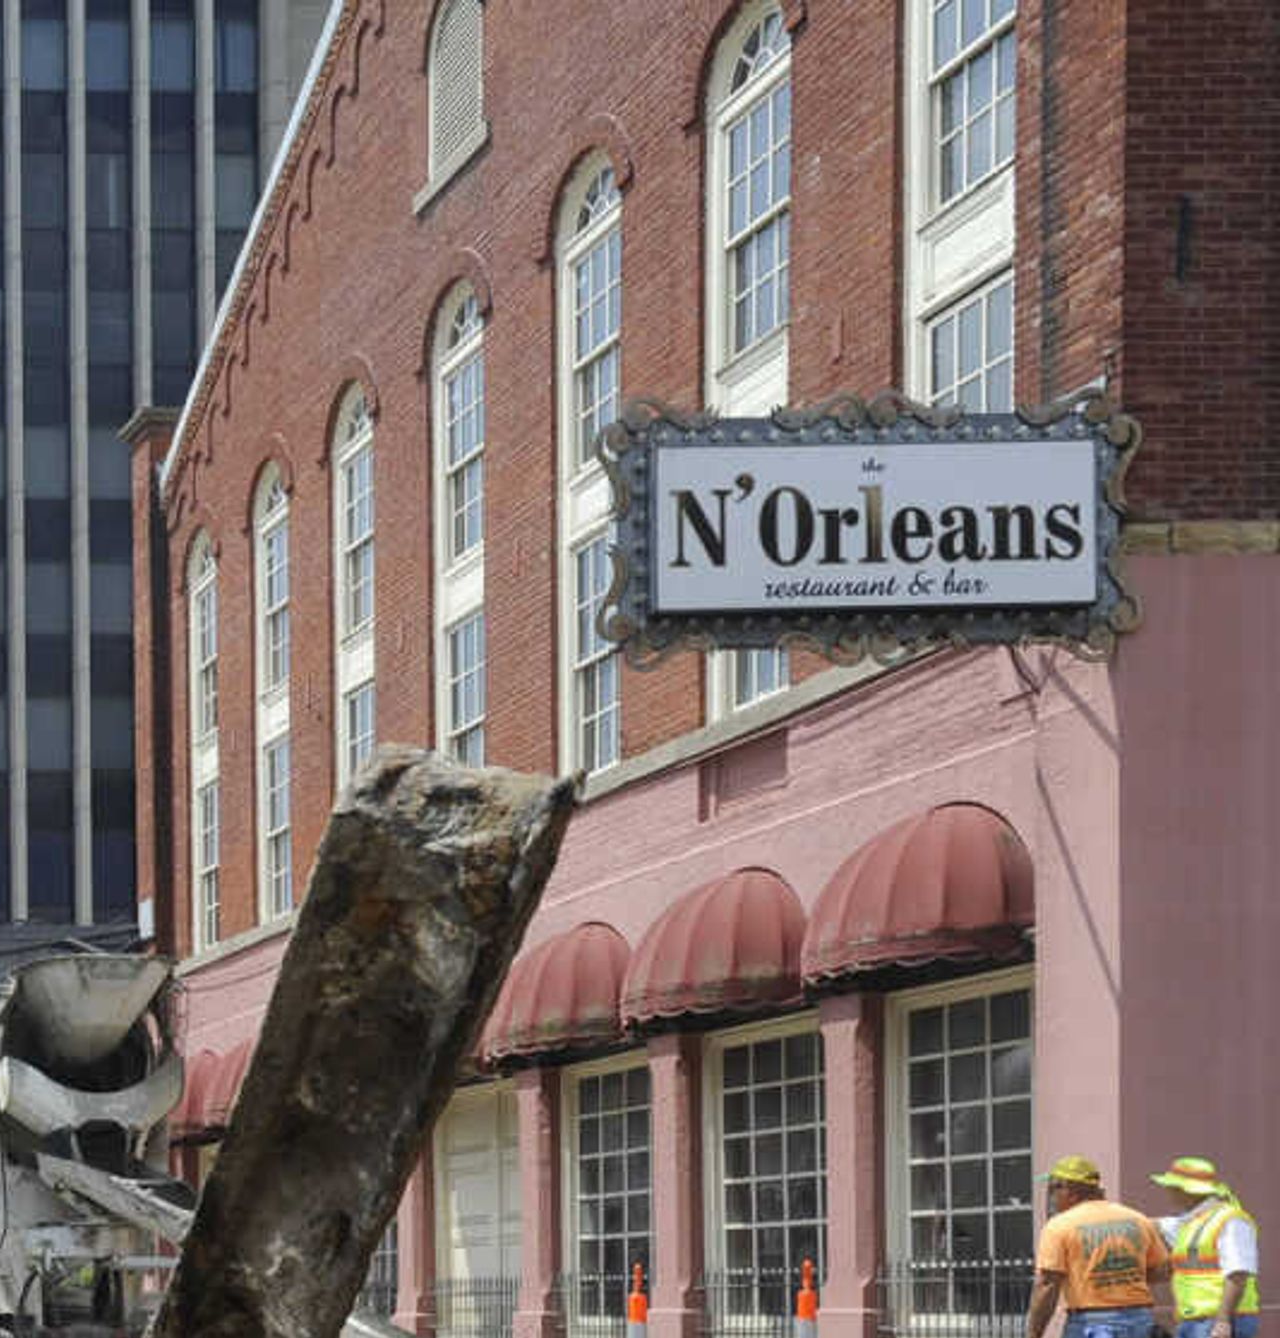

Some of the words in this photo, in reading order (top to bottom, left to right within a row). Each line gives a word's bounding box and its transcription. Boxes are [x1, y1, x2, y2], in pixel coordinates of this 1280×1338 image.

[668, 472, 1084, 569] N'Orleans
[764, 575, 898, 599] restaurant
[907, 567, 936, 597] &
[943, 567, 989, 596] bar
